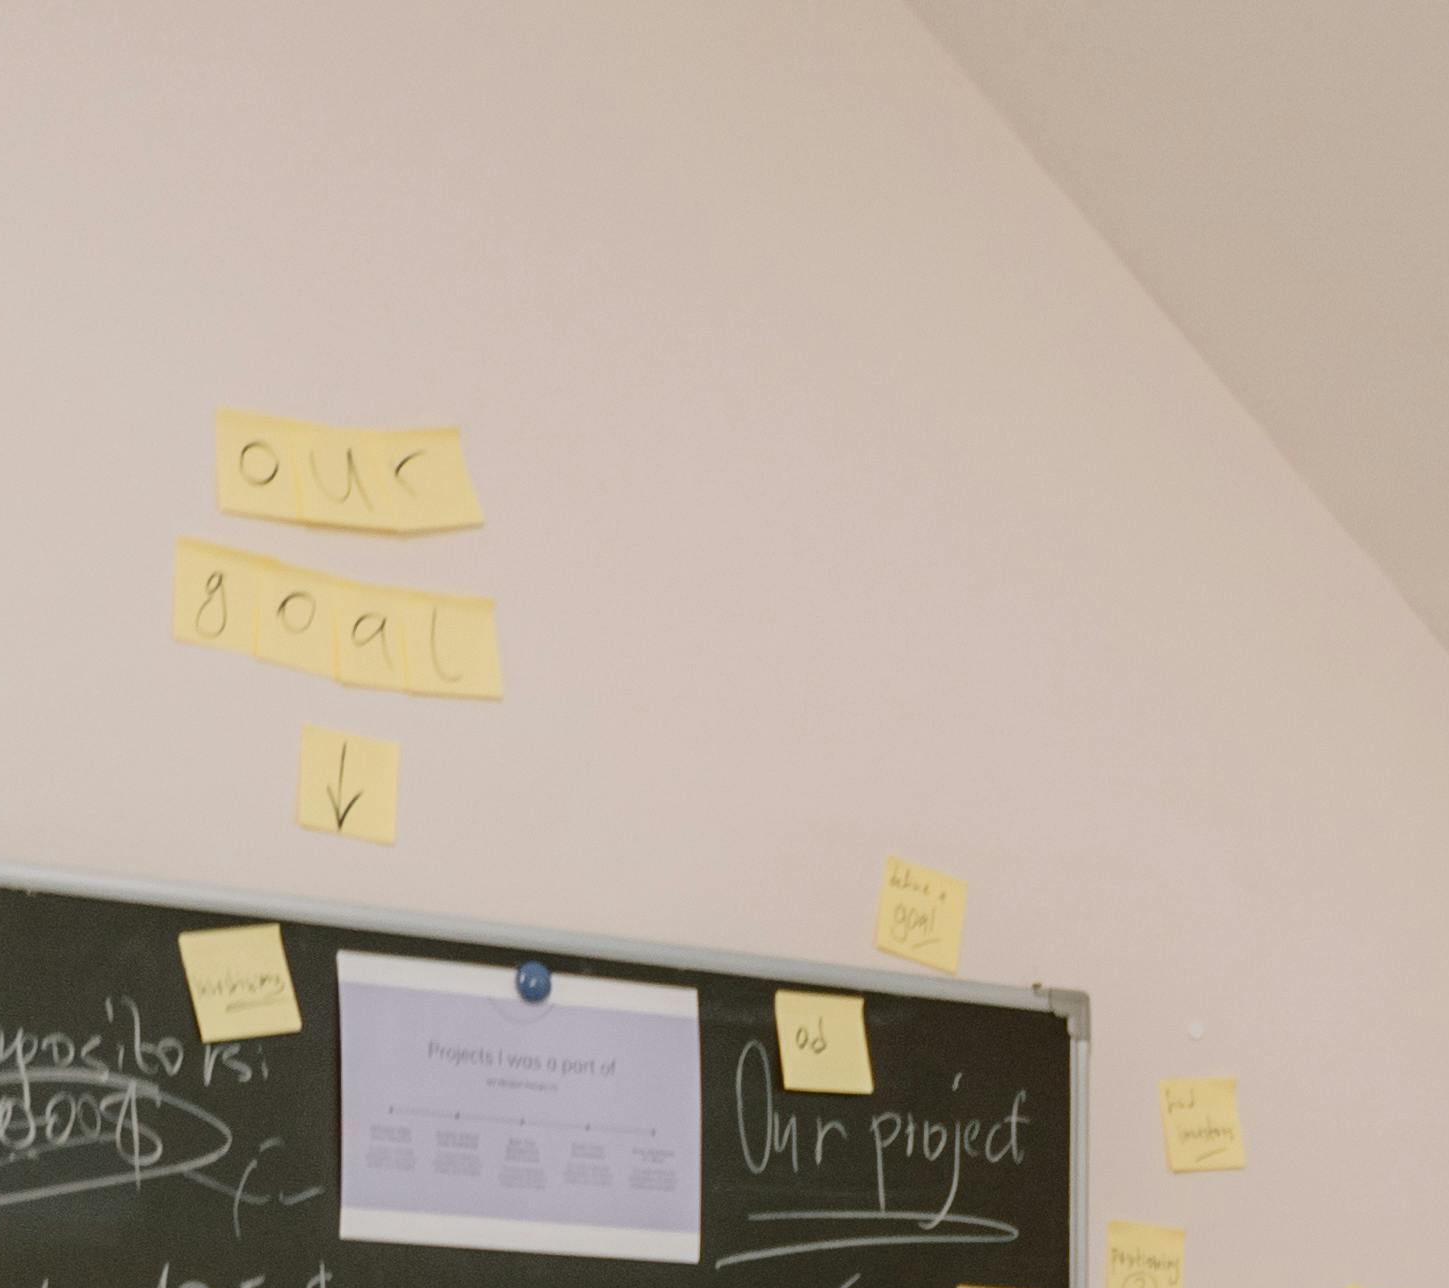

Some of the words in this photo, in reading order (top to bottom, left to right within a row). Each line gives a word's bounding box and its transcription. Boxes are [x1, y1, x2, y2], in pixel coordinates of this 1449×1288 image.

[194, 570, 464, 683] goal
[427, 1040, 494, 1067] Projects
[507, 1053, 542, 1072] was
[546, 1057, 557, 1073] a
[561, 1058, 596, 1076] part
[599, 1057, 617, 1077] of
[736, 1040, 848, 1175] Our
[870, 1072, 1031, 1231] project
